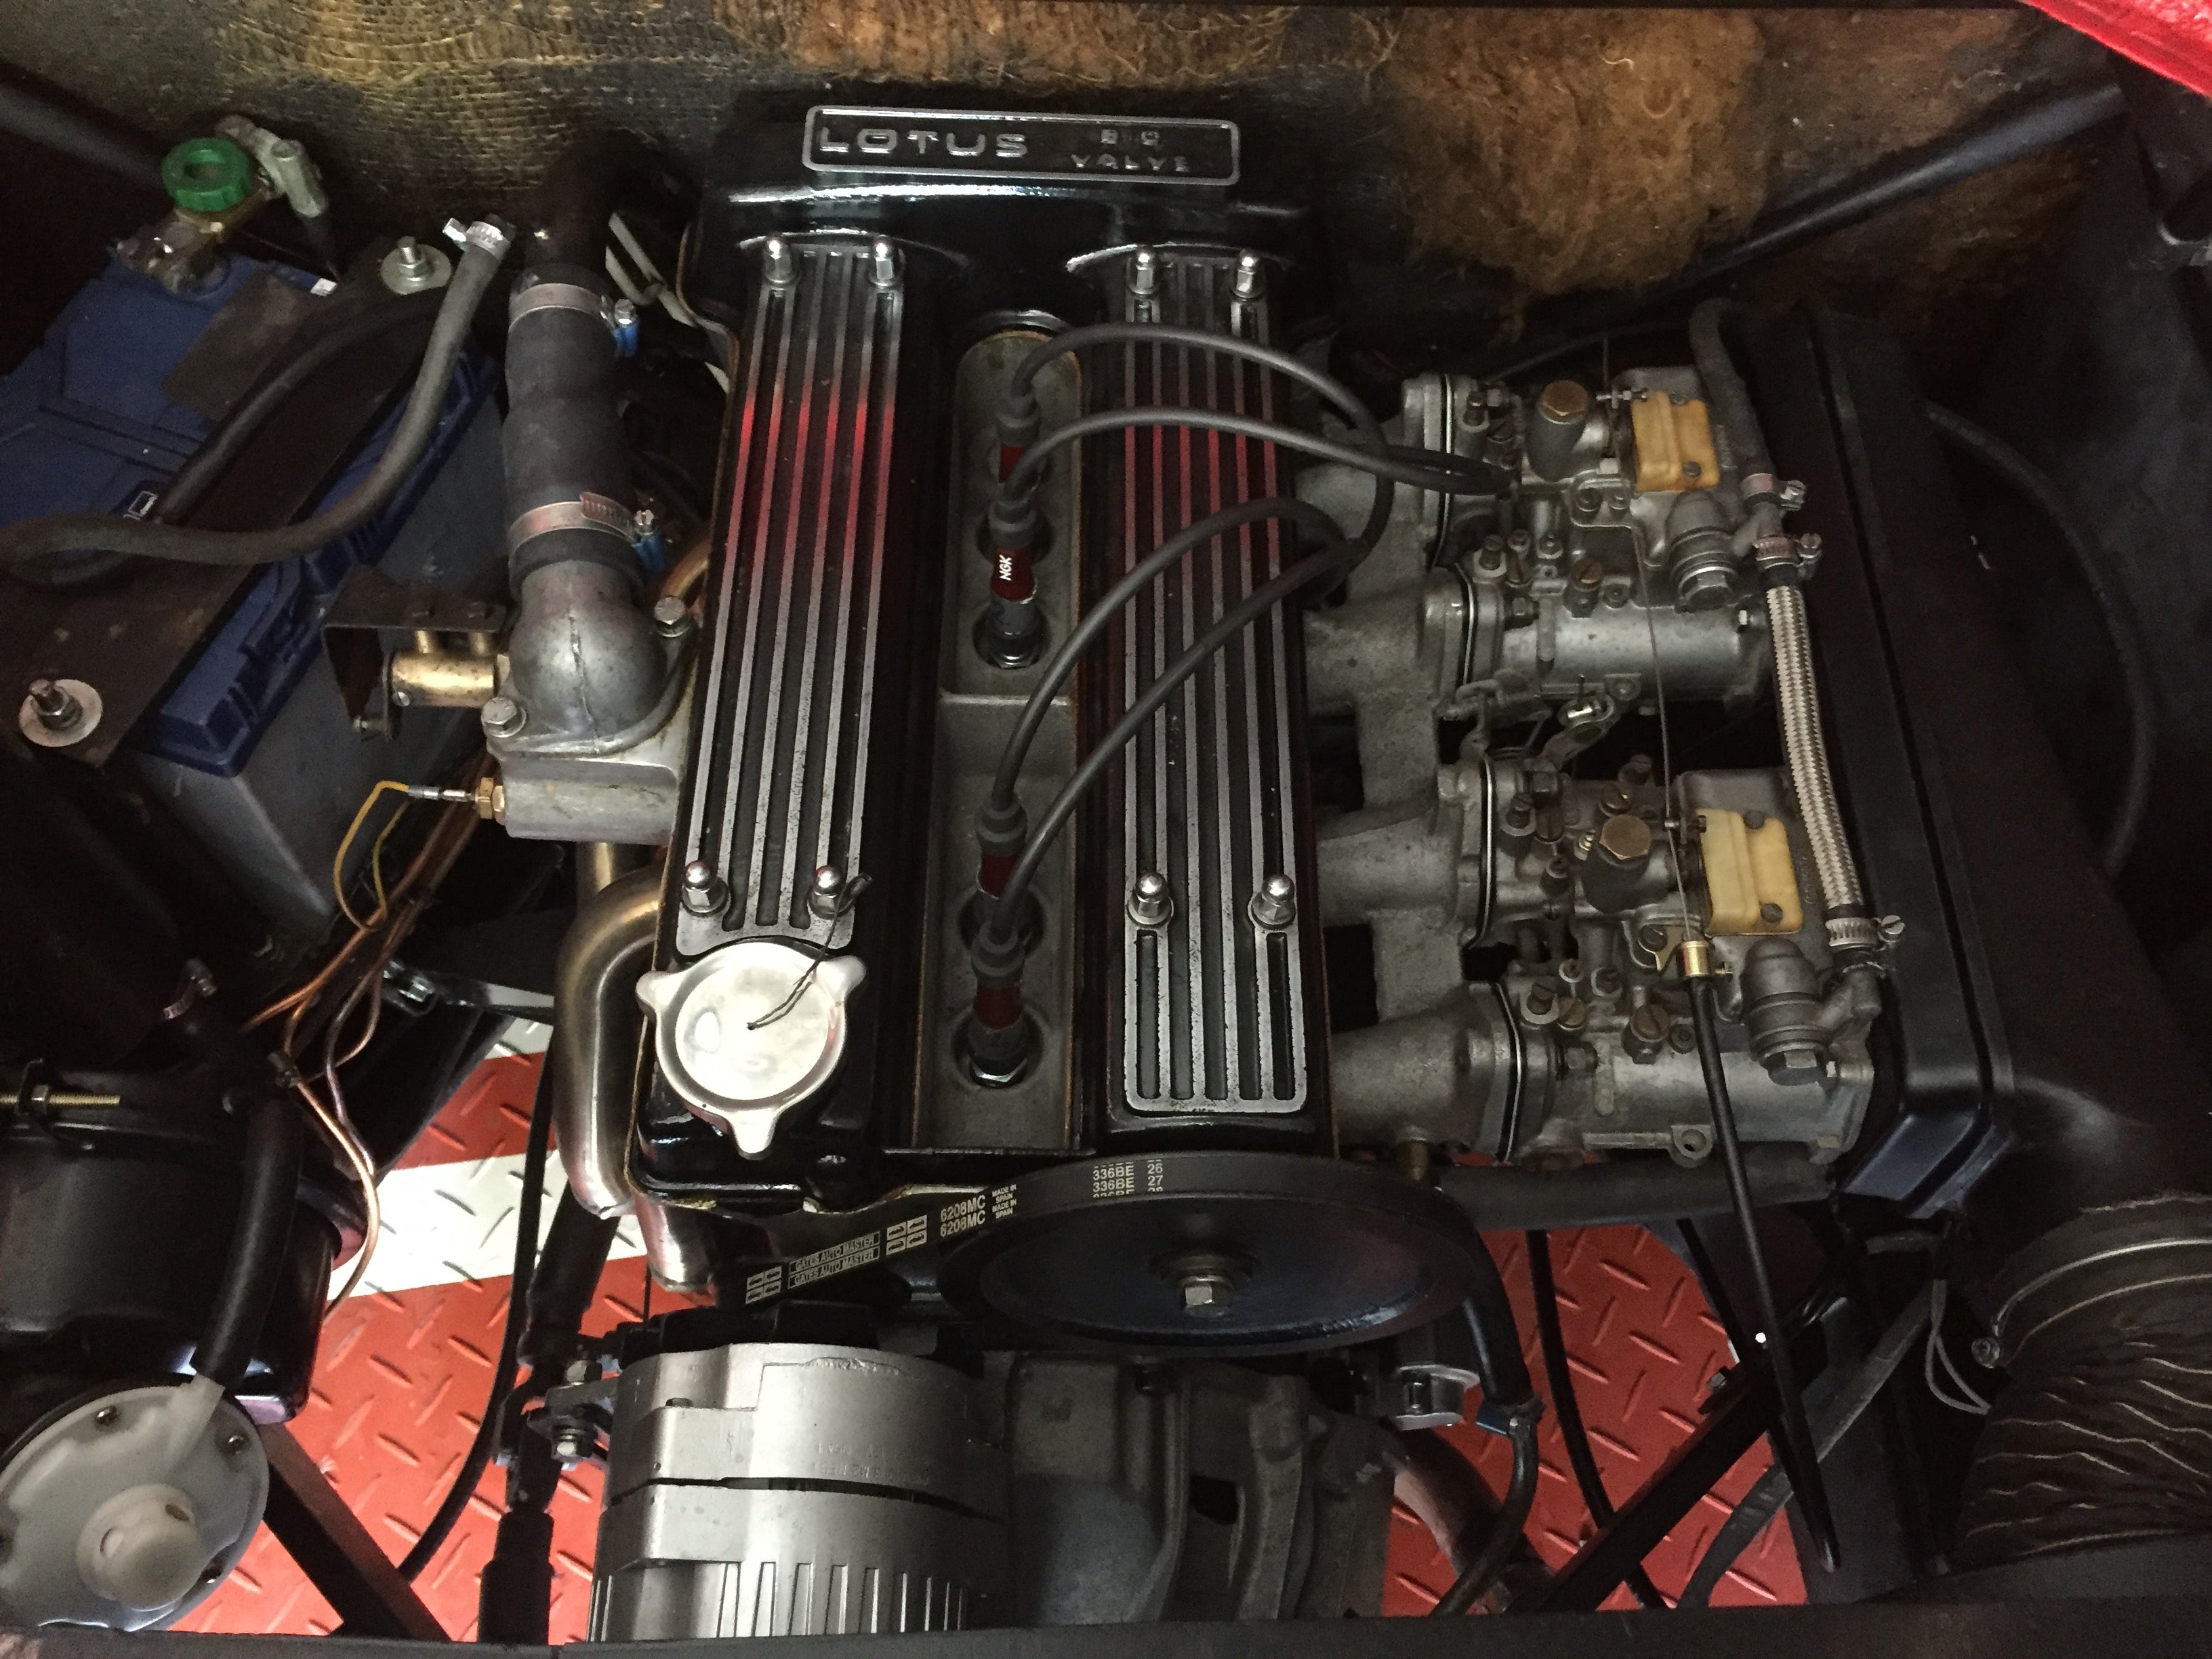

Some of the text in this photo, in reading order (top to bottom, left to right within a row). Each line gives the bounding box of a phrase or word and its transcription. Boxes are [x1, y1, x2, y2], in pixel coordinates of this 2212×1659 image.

[819, 127, 1027, 157] LOTUS
[999, 554, 1012, 581] NGK
[1092, 1165, 1134, 1181] 336BE
[1147, 1163, 1163, 1174] 26
[992, 1187, 1009, 1197] MADE
[1092, 1176, 1134, 1193] 336BE
[1147, 1175, 1164, 1186] 27
[940, 1194, 985, 1223] 6208MC
[992, 1201, 1009, 1212] MADE
[996, 1193, 1013, 1204] SPAIN
[940, 1210, 985, 1237] 6208MC
[996, 1207, 1013, 1218] SPAIN
[796, 1235, 874, 1271] GATES AUTO MASTER
[795, 1249, 874, 1286] GATES AUTO MASTER
